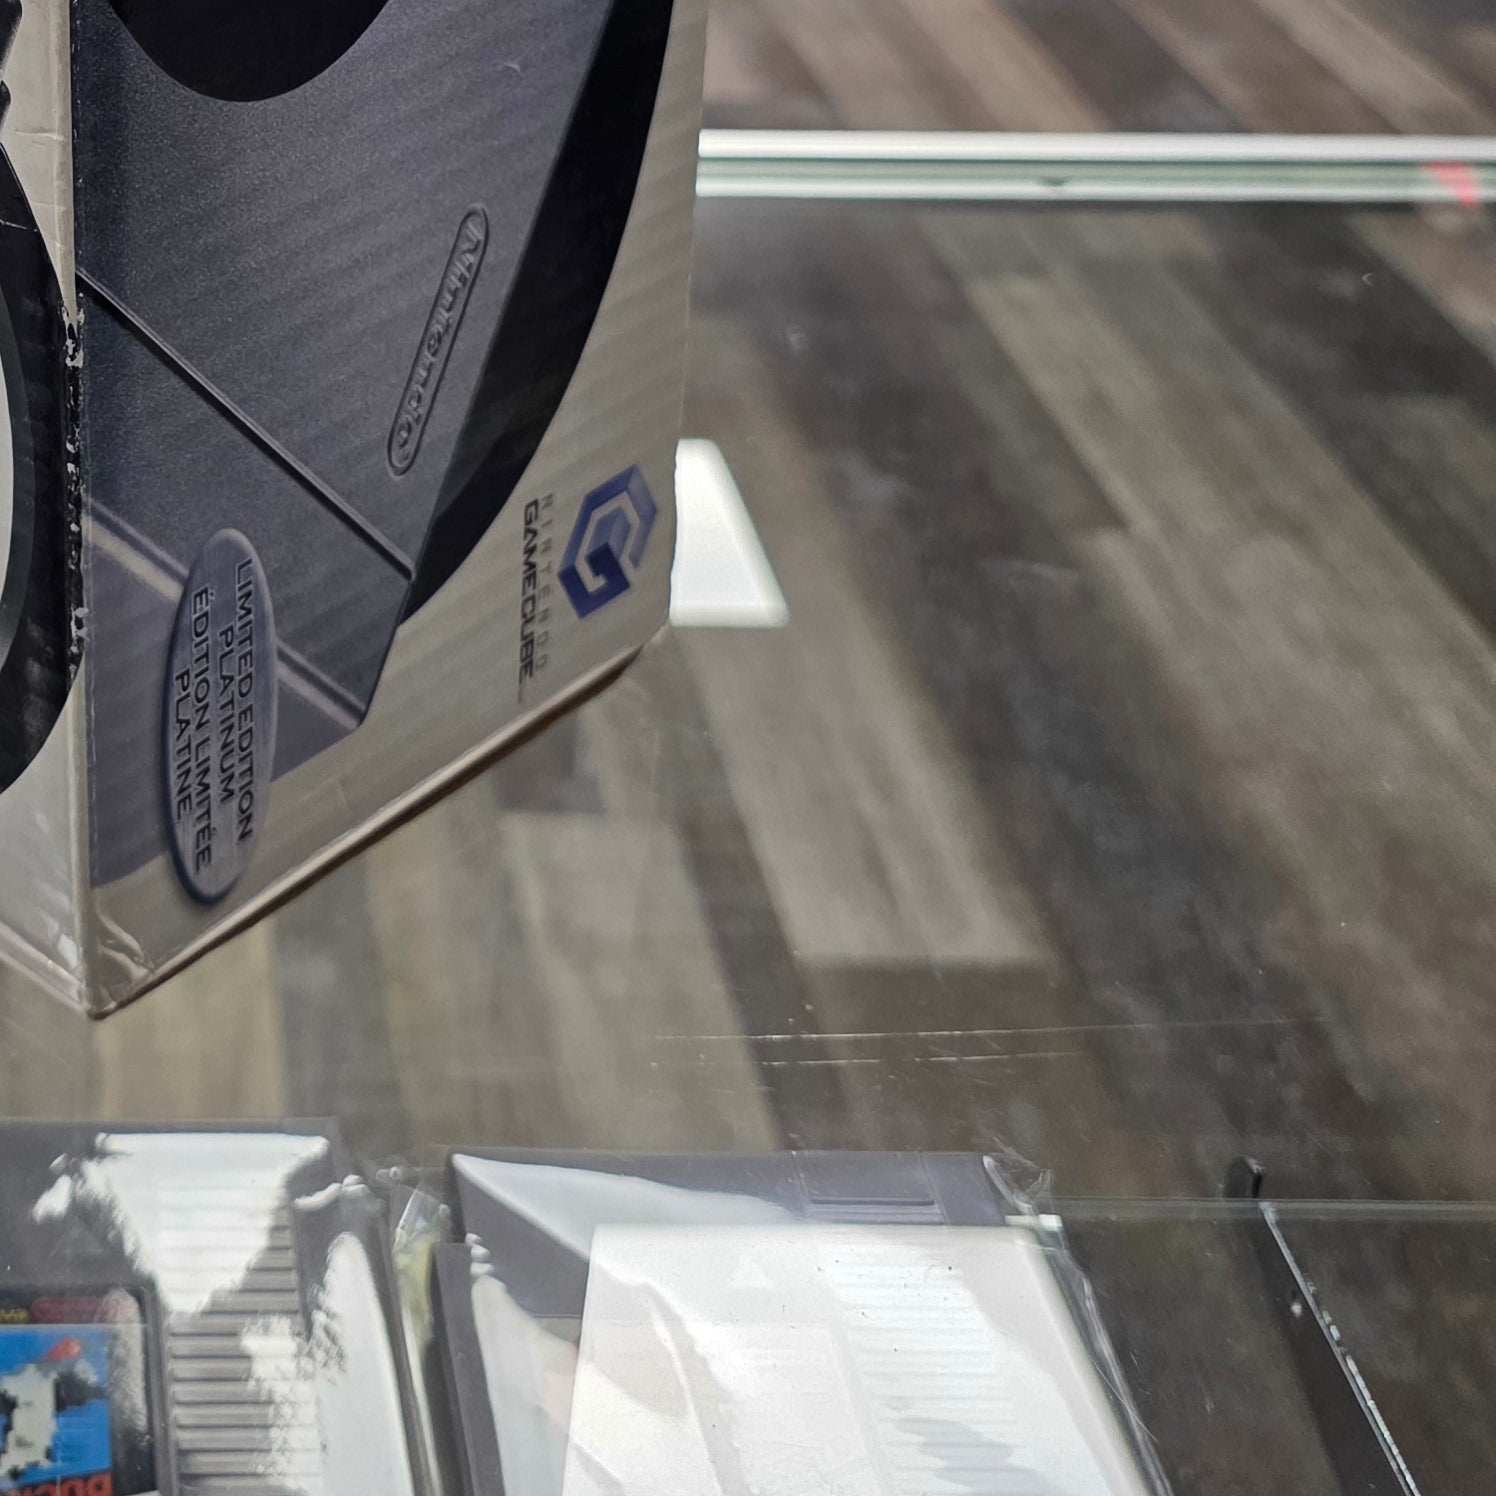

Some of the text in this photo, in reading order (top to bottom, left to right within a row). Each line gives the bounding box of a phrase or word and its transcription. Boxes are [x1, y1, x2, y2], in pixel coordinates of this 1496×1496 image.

[519, 499, 539, 685] GAMECUBE
[536, 493, 554, 670] NINTENDO
[175, 668, 193, 821] PLATINE
[192, 584, 216, 873] ÉDITION LIMITÉE
[218, 625, 236, 804] PLATINUM
[235, 558, 254, 842] LIMITED EDITION
